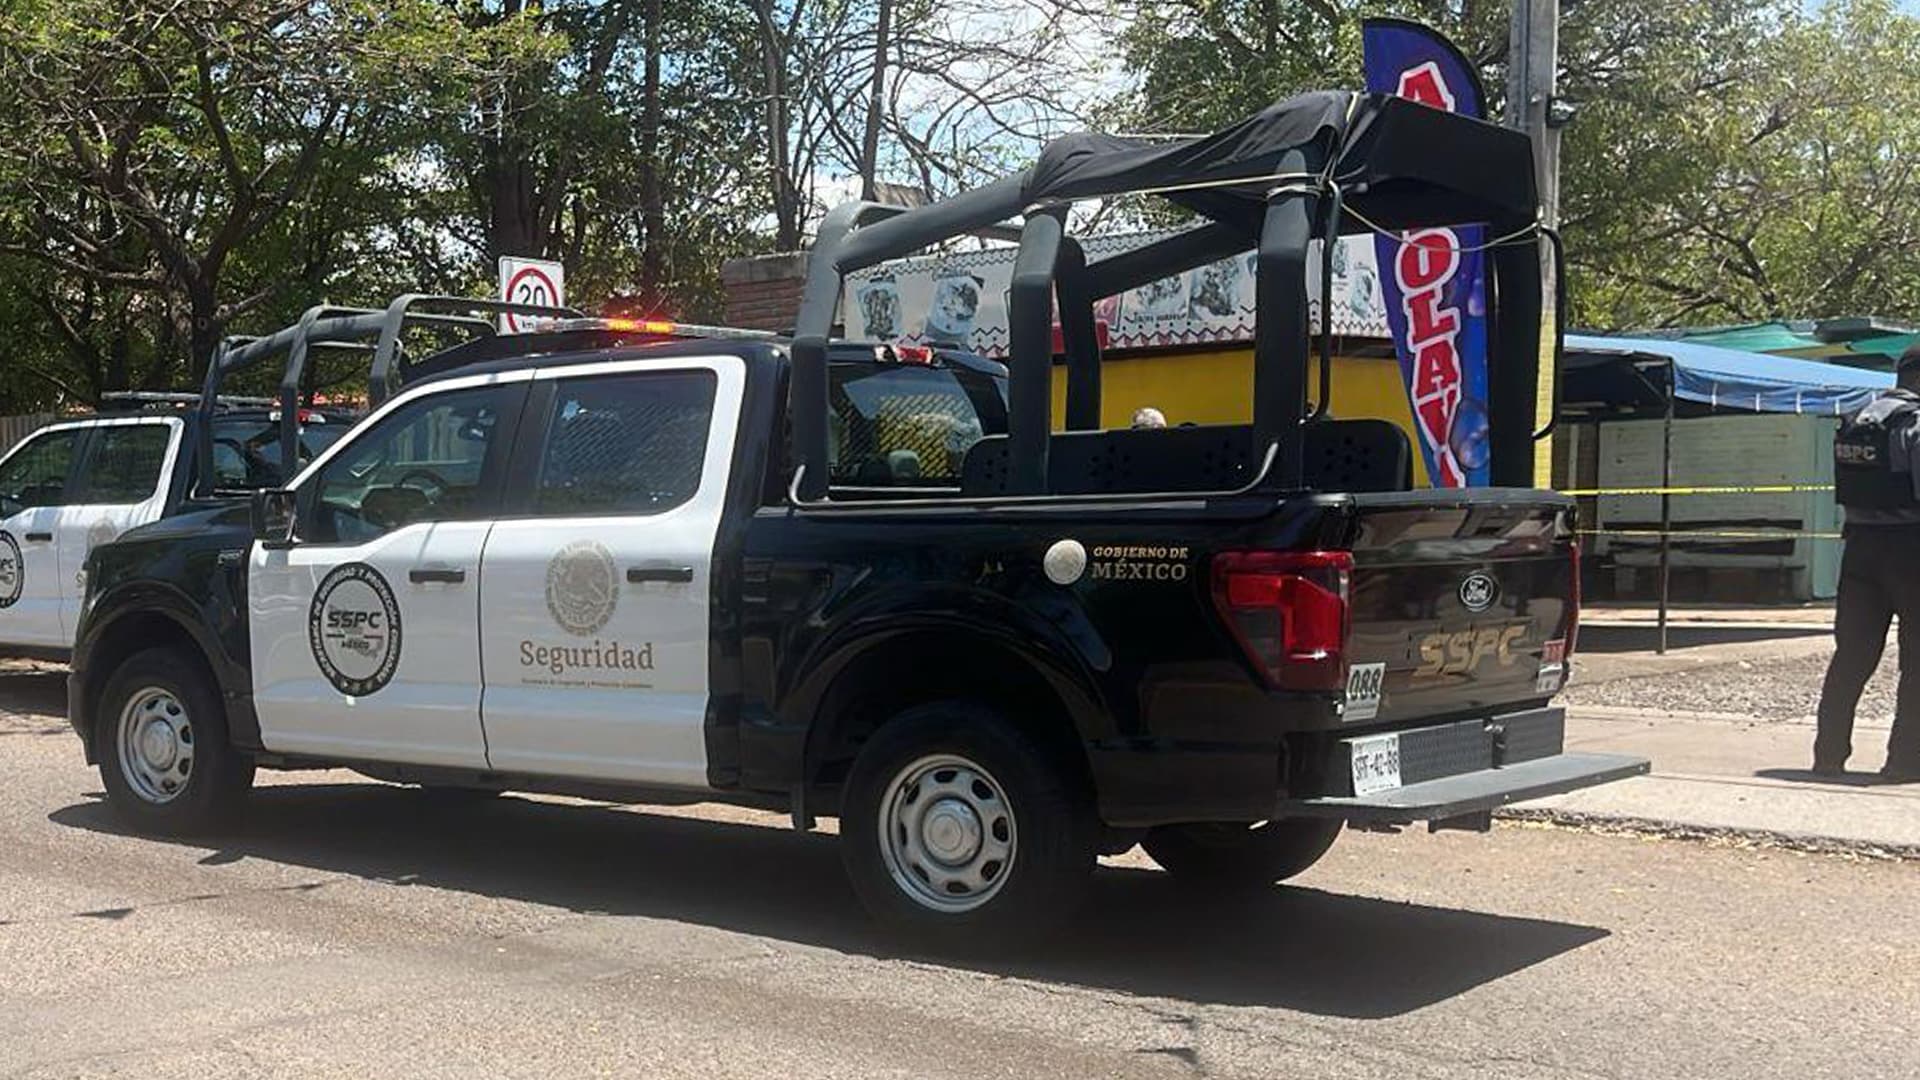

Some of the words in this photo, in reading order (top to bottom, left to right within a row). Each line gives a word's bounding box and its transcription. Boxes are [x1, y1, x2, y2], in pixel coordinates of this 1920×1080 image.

[519, 284, 546, 306] 20
[1093, 546, 1167, 559] GOBIERNO
[1169, 547, 1189, 559] DE
[1092, 558, 1187, 580] MÉXICO
[327, 611, 382, 628] SSPC
[520, 640, 655, 674] Seguridad
[1412, 625, 1527, 676] SSPC
[1349, 667, 1381, 700] 088
